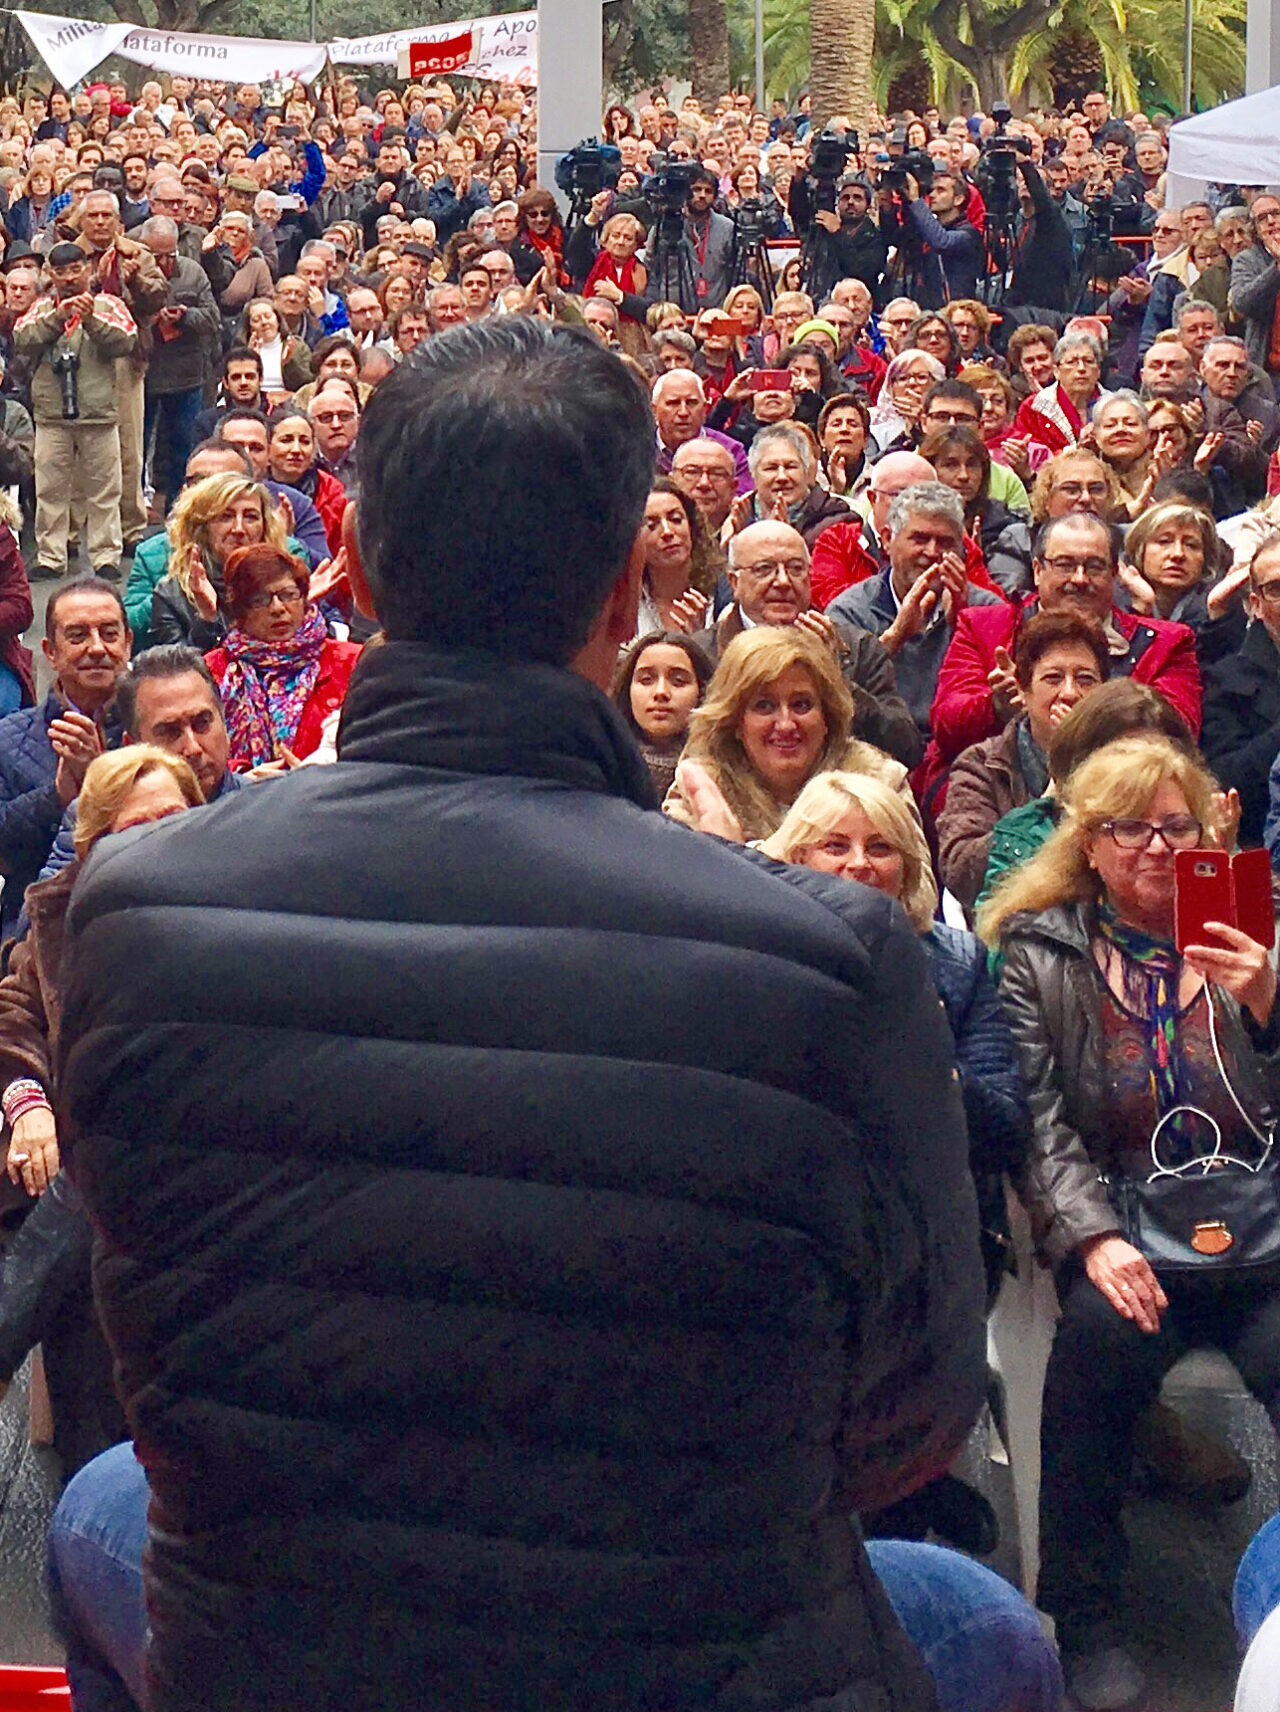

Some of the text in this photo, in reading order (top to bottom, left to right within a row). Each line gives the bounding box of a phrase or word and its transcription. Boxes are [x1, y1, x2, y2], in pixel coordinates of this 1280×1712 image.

[493, 19, 537, 41] Apo
[121, 33, 228, 60] lataforma
[482, 45, 527, 58] chez
